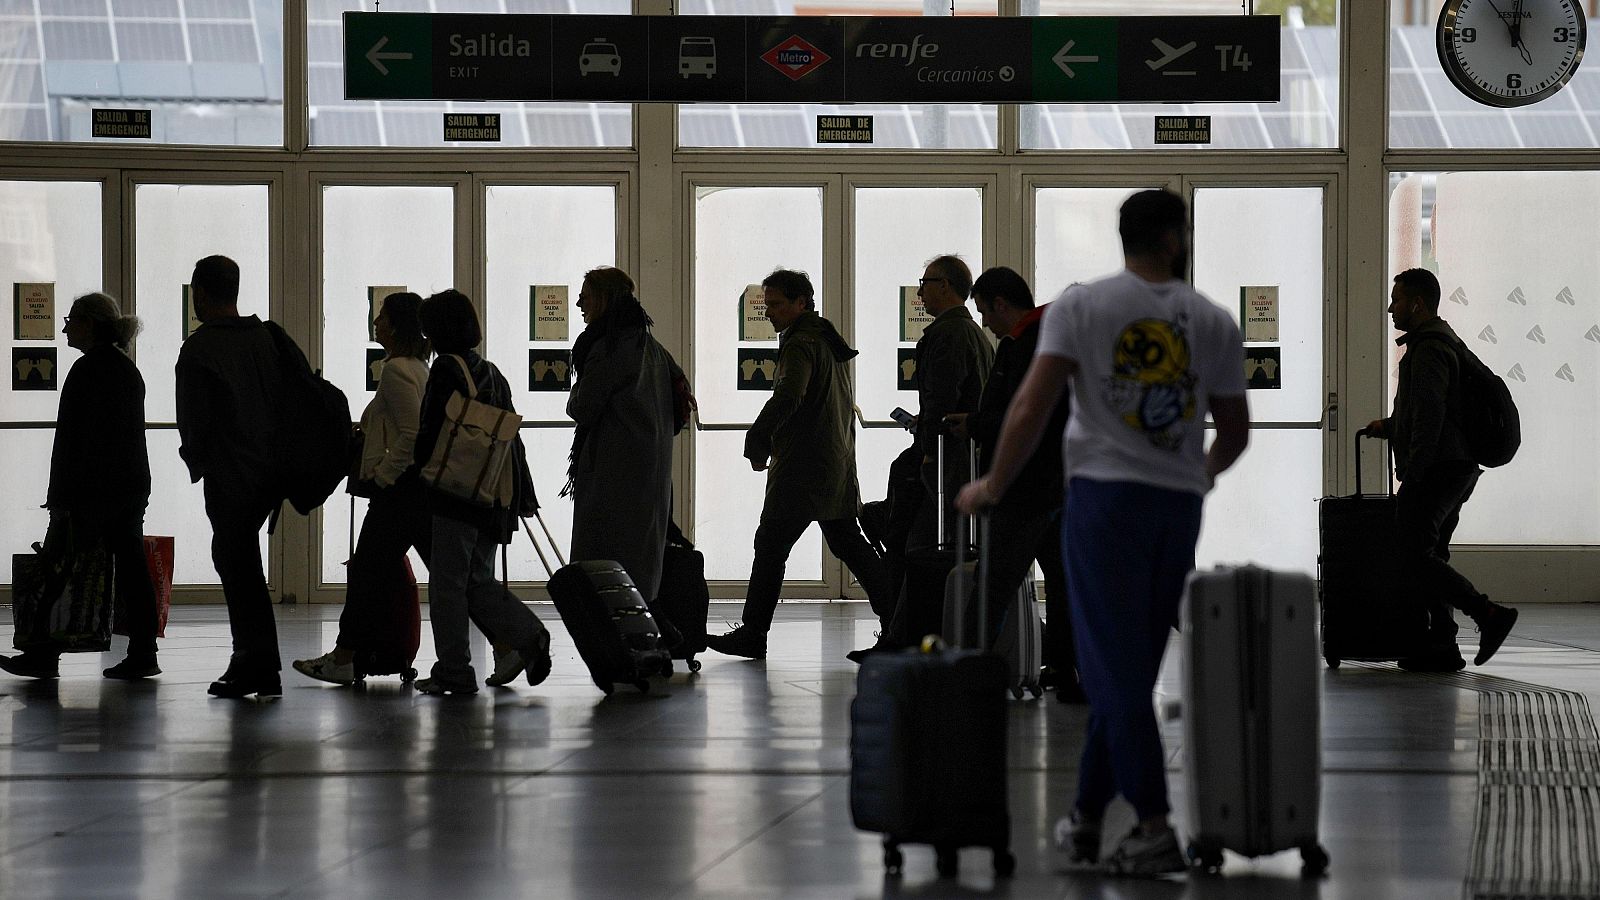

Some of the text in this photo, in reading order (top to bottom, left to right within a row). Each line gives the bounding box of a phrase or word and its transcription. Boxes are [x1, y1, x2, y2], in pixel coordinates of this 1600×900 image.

[1461, 27, 1477, 43] 9
[1553, 27, 1569, 43] 3
[449, 32, 531, 57] Salida
[855, 34, 939, 67] renfe
[780, 52, 810, 63] Metro
[1214, 45, 1253, 72] T4
[450, 66, 480, 78] EXIT
[917, 66, 995, 83] Cercanías
[1506, 73, 1522, 89] 6
[96, 111, 147, 123] SALIDA DE
[447, 115, 497, 127] SALIDA DE
[820, 117, 869, 129] SALIDA DE
[1158, 118, 1207, 129] SALIDA DE
[94, 124, 149, 136] EMERGENCIA
[445, 128, 499, 139] EMERGENCIA
[818, 130, 871, 141] EMERGENCIA
[1156, 130, 1209, 141] EMERGENCIA
